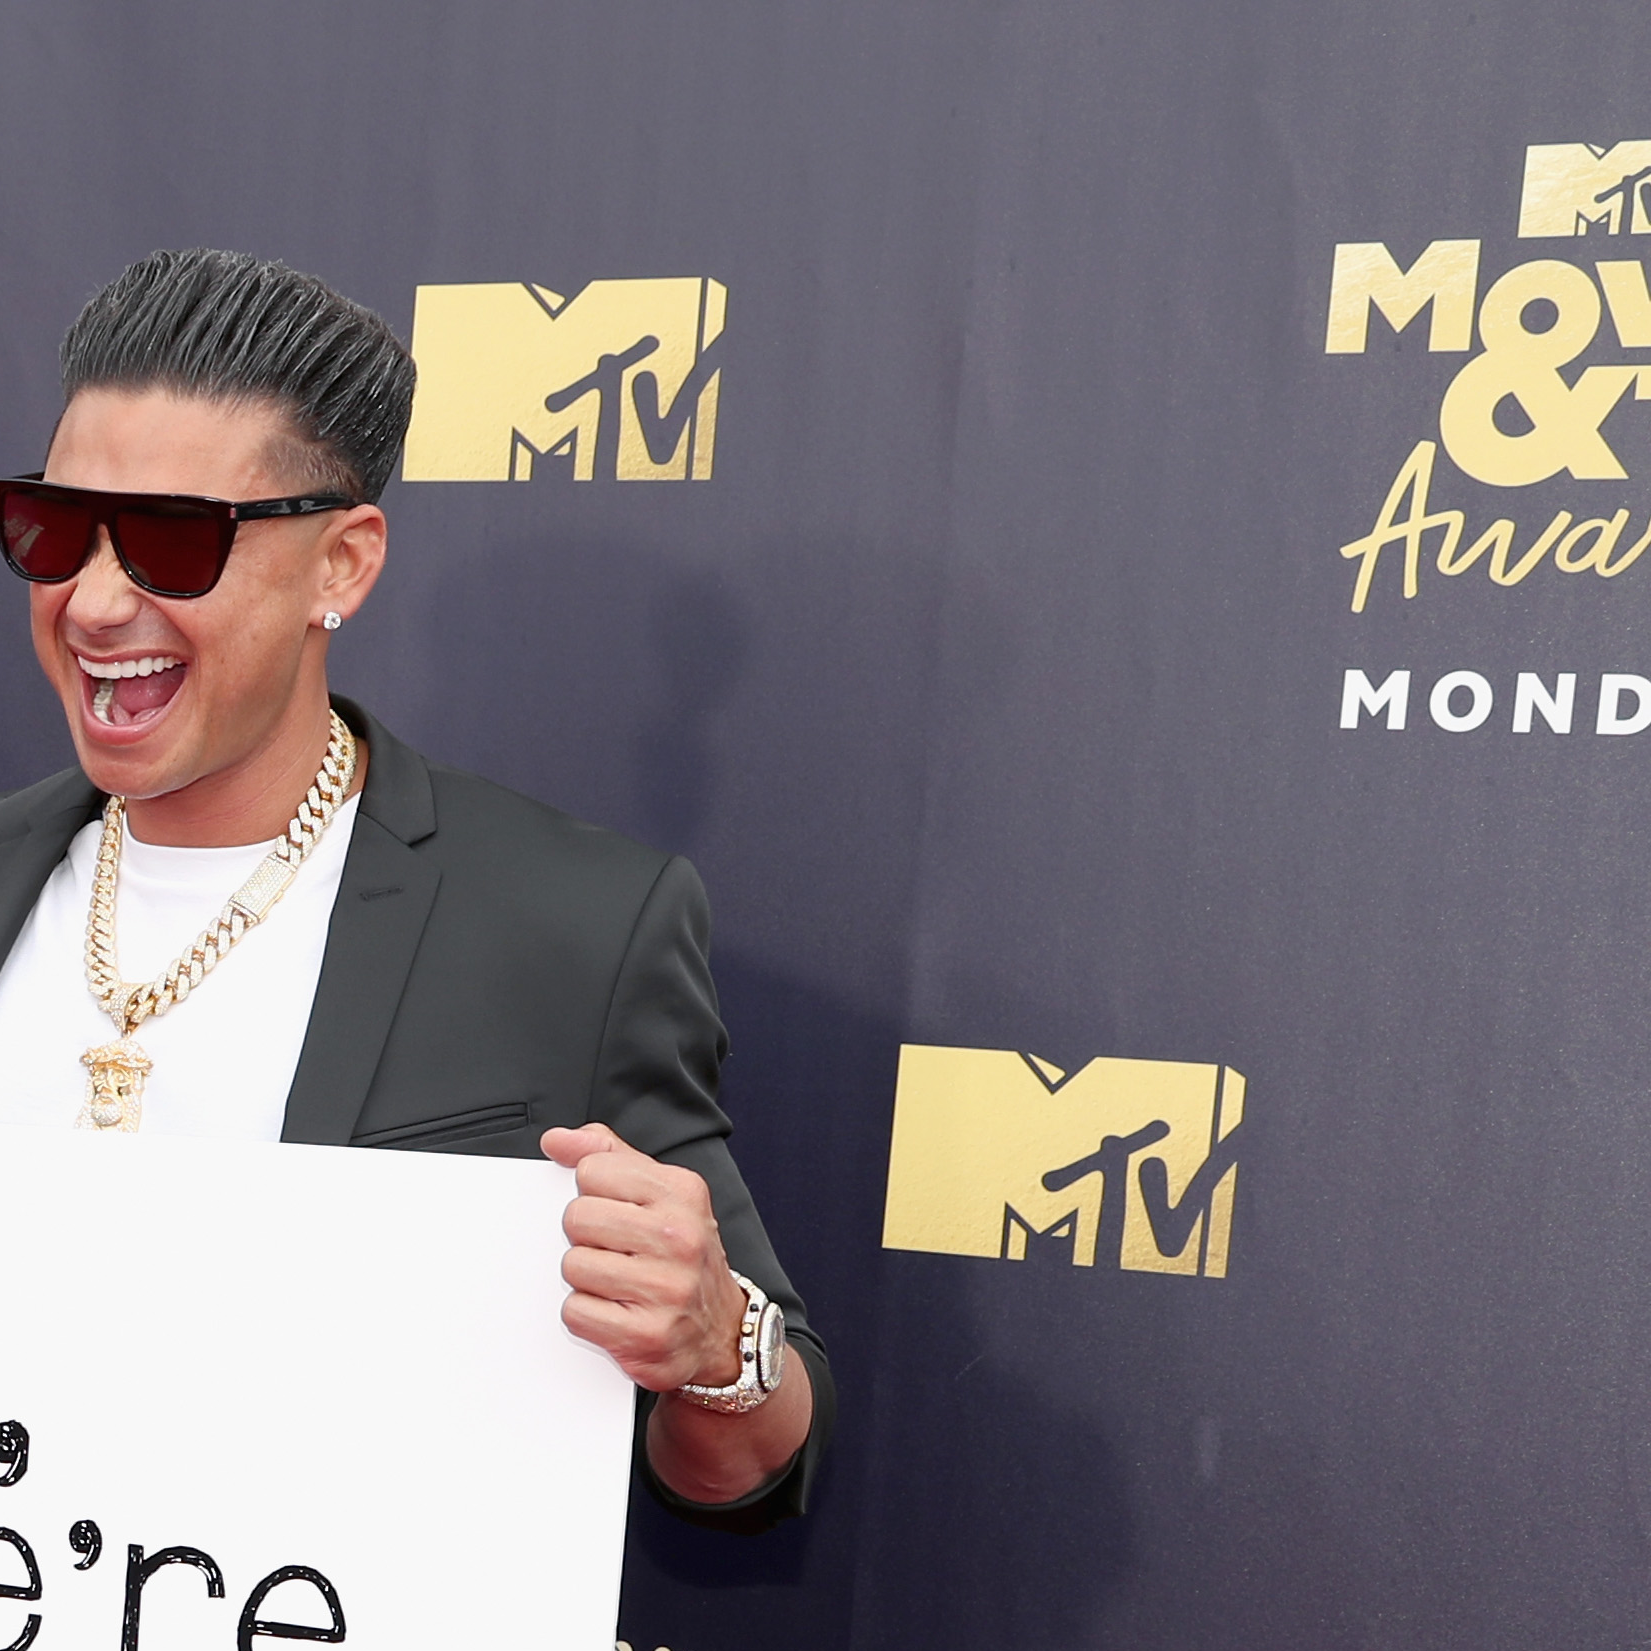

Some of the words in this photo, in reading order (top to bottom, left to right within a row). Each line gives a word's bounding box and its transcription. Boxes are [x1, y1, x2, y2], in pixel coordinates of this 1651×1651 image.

[401, 276, 727, 482] MTV
[1340, 440, 1651, 613] Awa
[1340, 669, 1651, 735] MOND
[882, 1043, 1246, 1279] MTV
